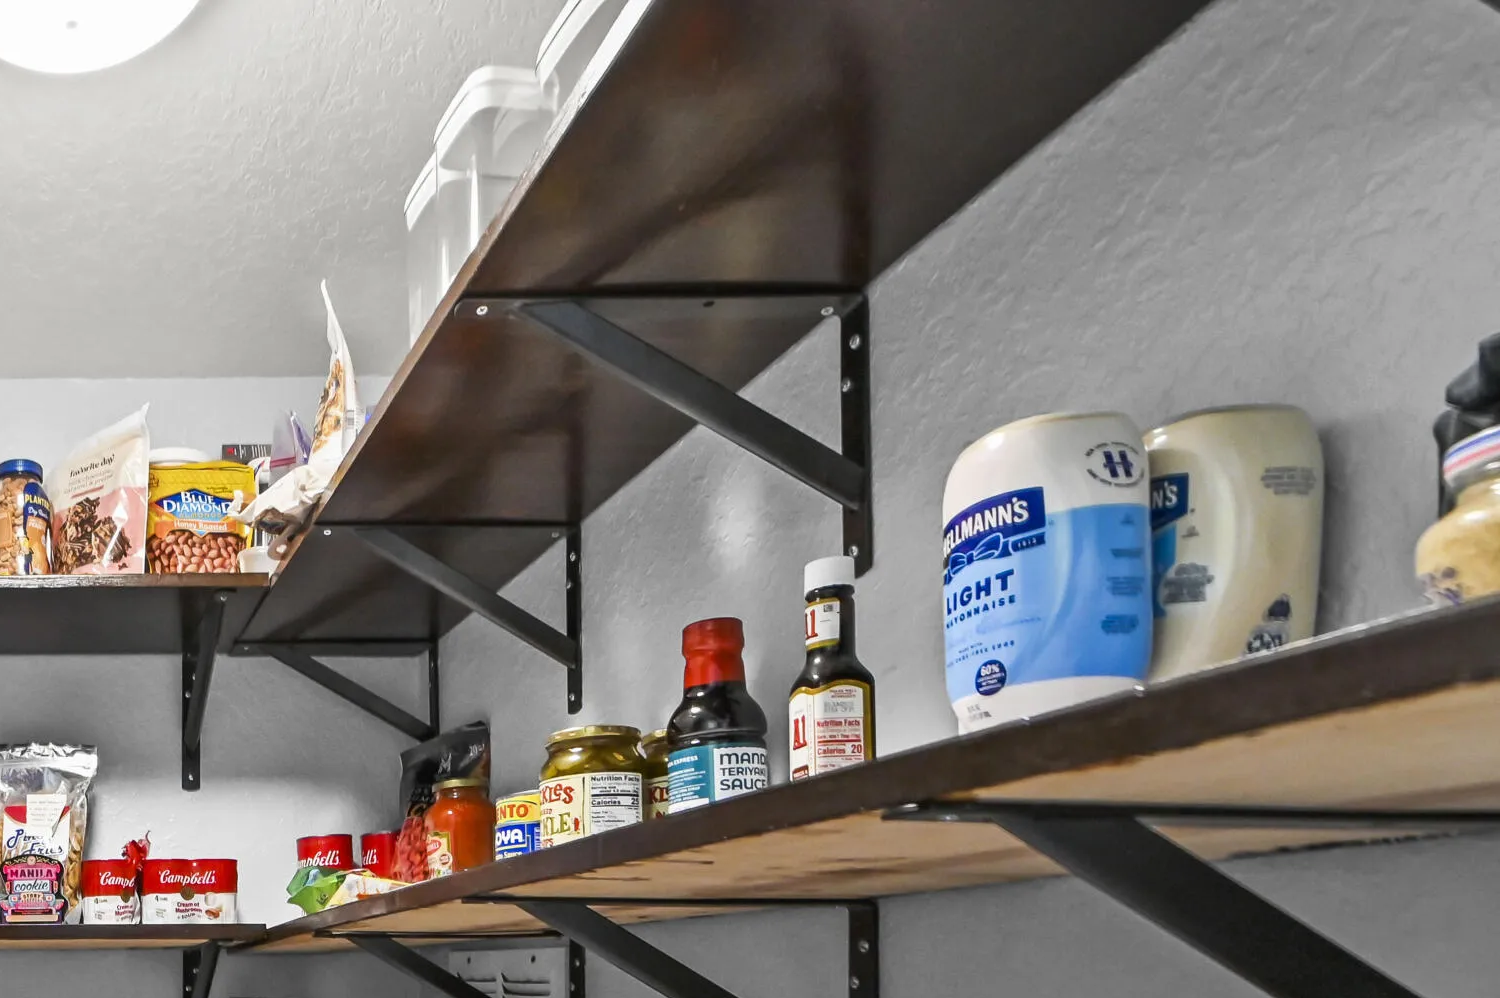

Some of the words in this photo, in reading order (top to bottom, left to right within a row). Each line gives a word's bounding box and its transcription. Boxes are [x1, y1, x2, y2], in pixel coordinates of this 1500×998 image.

[181, 491, 214, 504] BLUE
[163, 500, 232, 514] DIAMOND
[174, 520, 197, 530] Honey
[199, 522, 228, 531] Roasted
[946, 568, 1014, 616] LIGHT
[851, 744, 862, 754] 20
[631, 798, 640, 806] 25
[10, 869, 53, 879] MANILA
[159, 869, 216, 885] Campbell's
[14, 881, 49, 892] cookie
